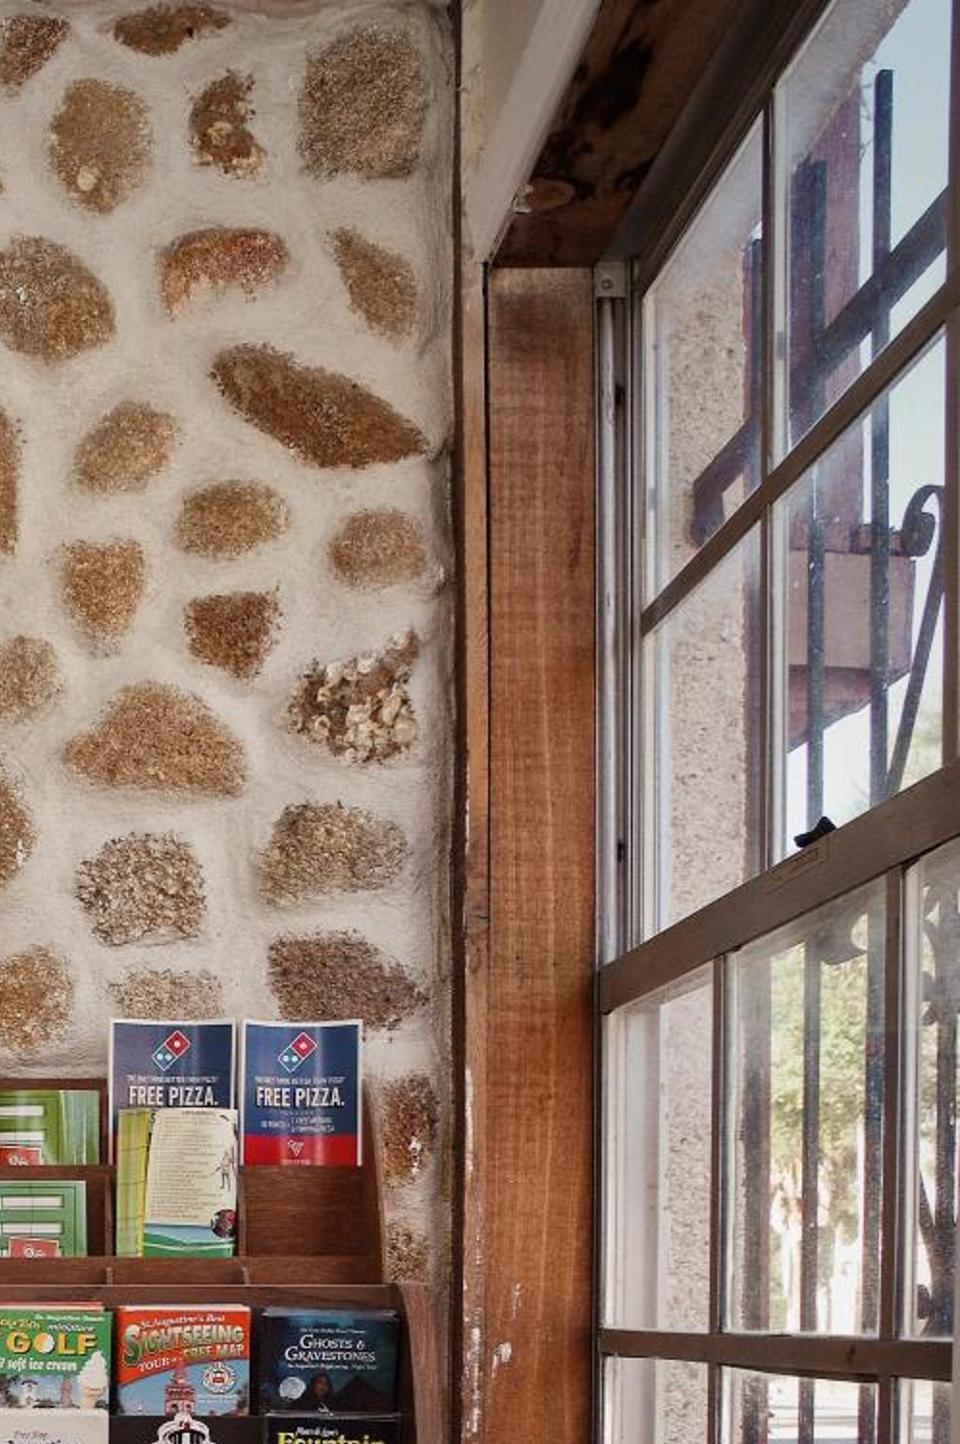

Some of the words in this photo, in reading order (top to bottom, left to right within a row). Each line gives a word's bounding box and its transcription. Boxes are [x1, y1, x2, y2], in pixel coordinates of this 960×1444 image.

[129, 1086, 163, 1105] FREE
[169, 1086, 219, 1106] PIZZA.
[256, 1087, 290, 1106] FREE
[295, 1087, 345, 1106] PIZZA.
[6, 1331, 97, 1355] GOLF
[123, 1324, 244, 1367] SIGHTSEEING
